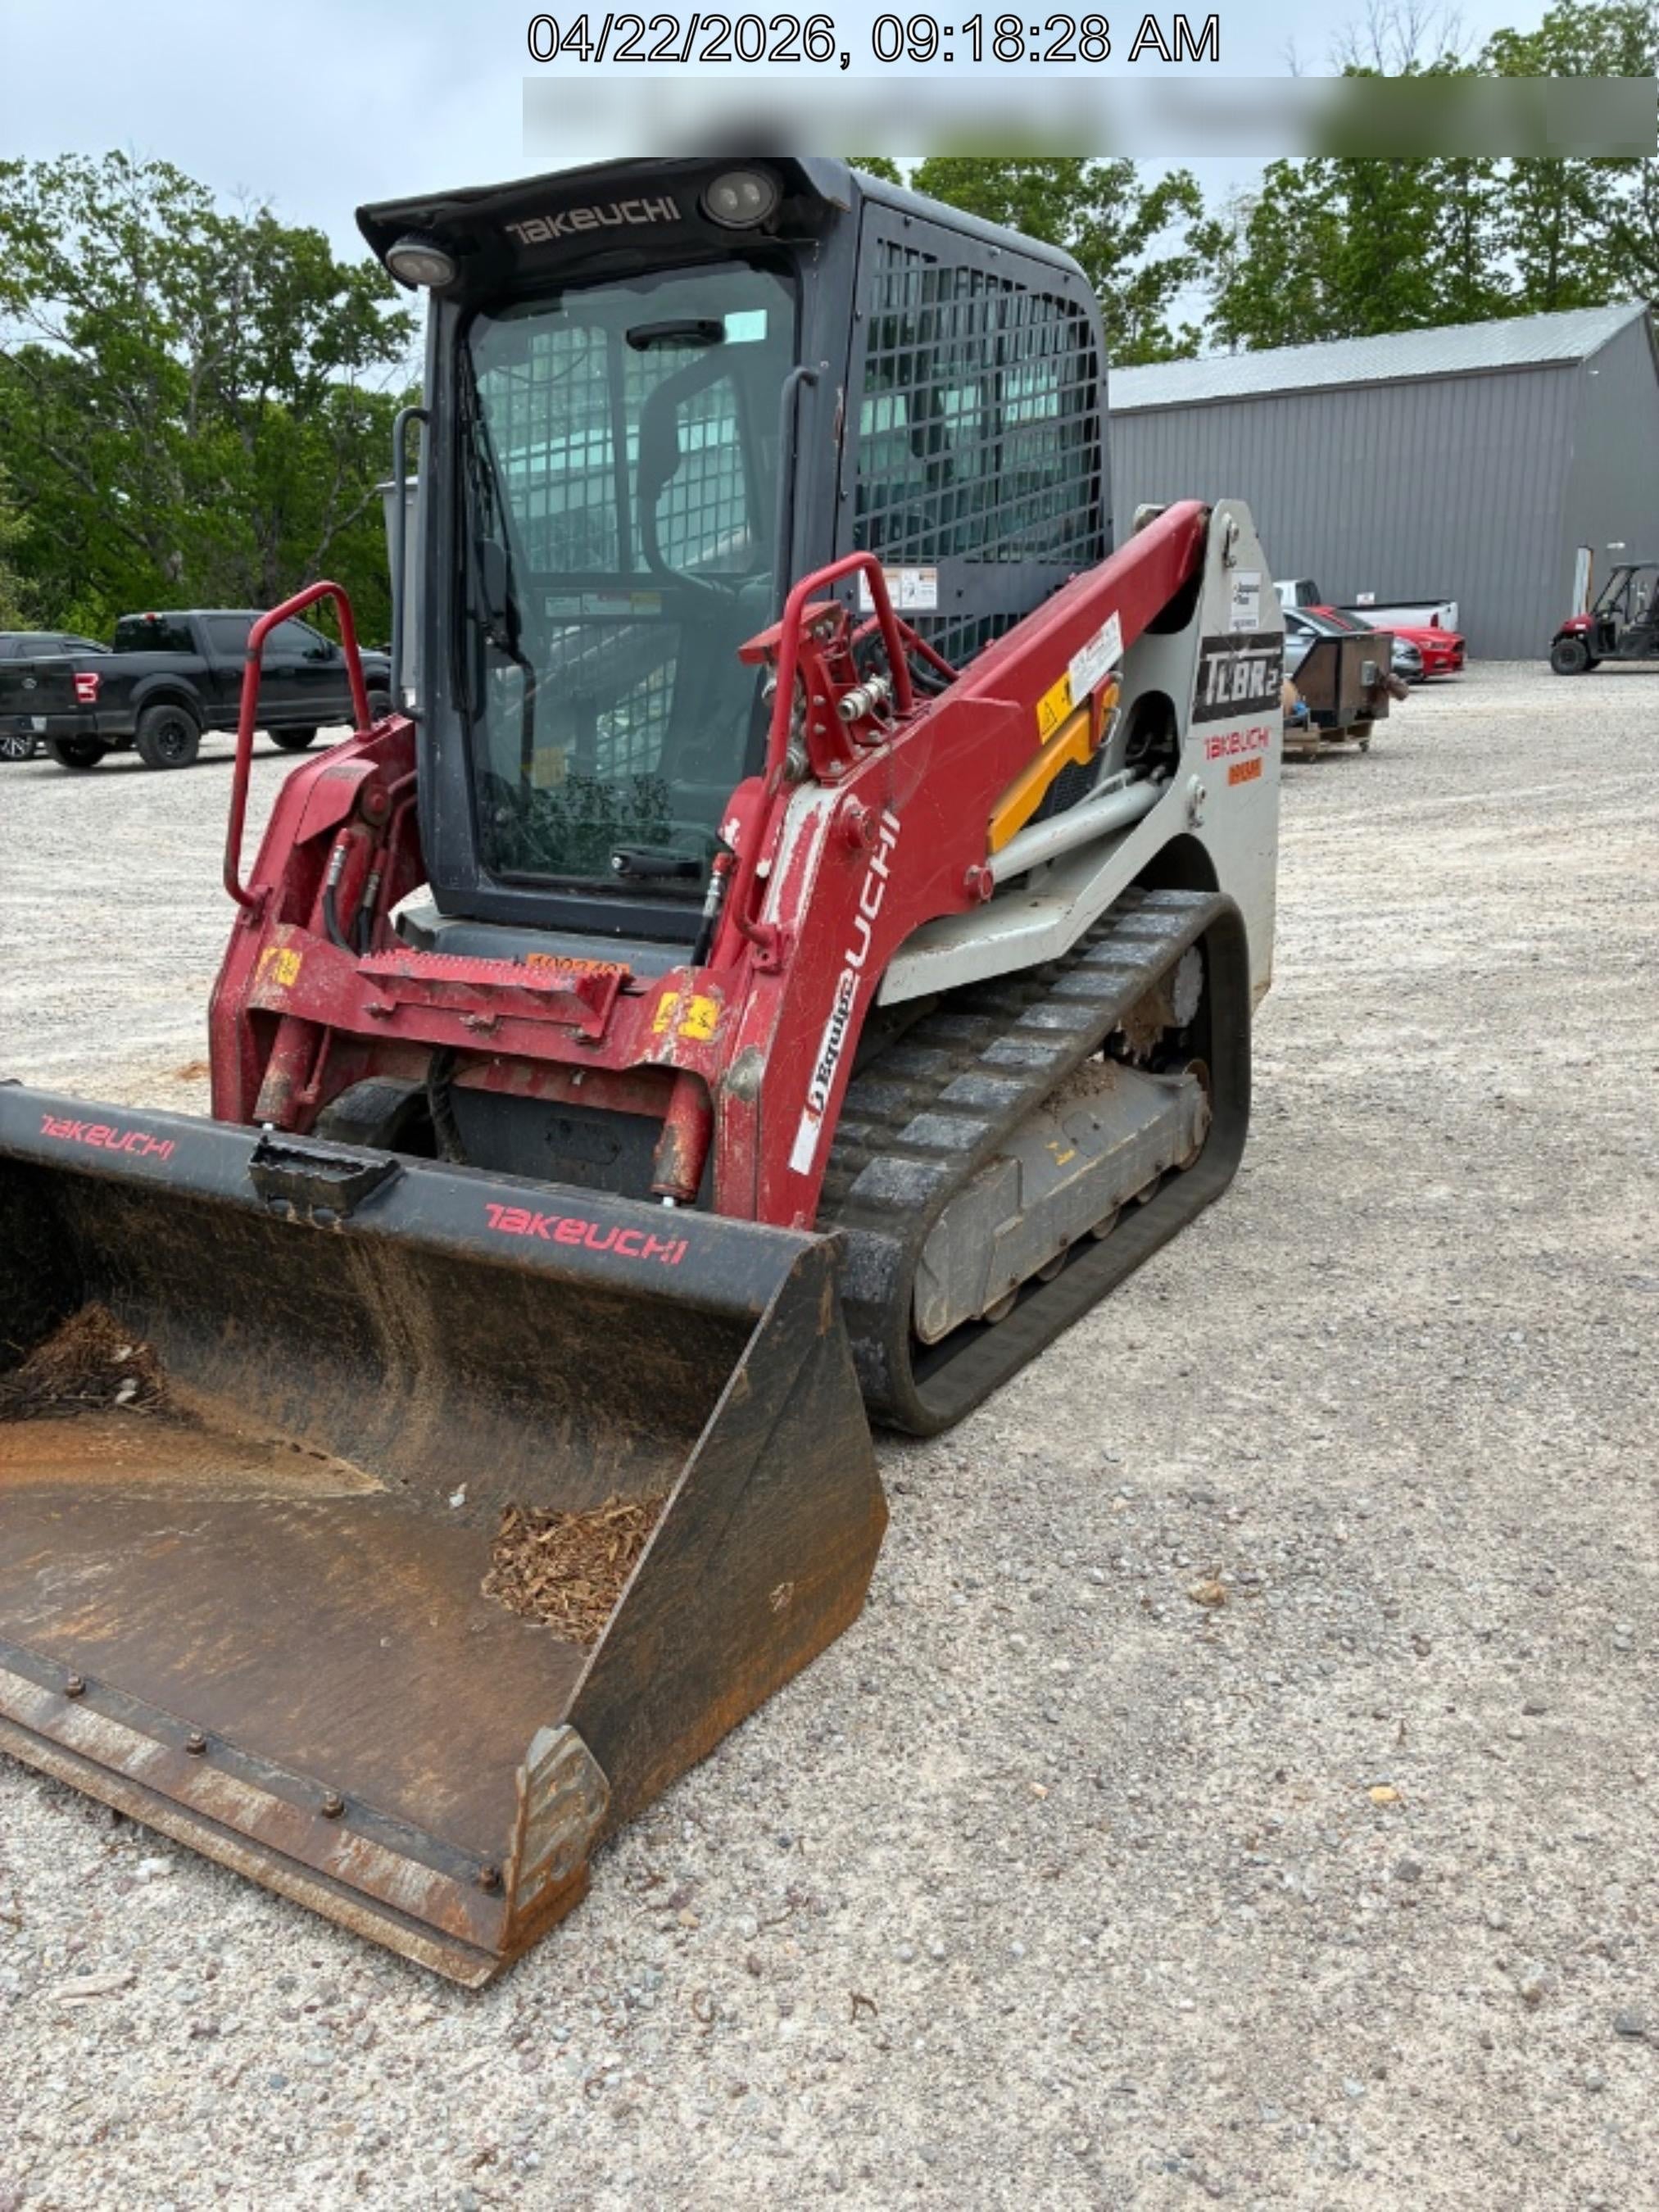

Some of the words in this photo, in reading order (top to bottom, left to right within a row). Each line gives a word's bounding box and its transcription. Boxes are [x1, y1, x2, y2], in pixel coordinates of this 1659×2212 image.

[504, 196, 682, 245] TAKEUCHI
[40, 1113, 175, 1162] TAKEUCHI
[485, 1202, 690, 1266] TAKEUCHI
